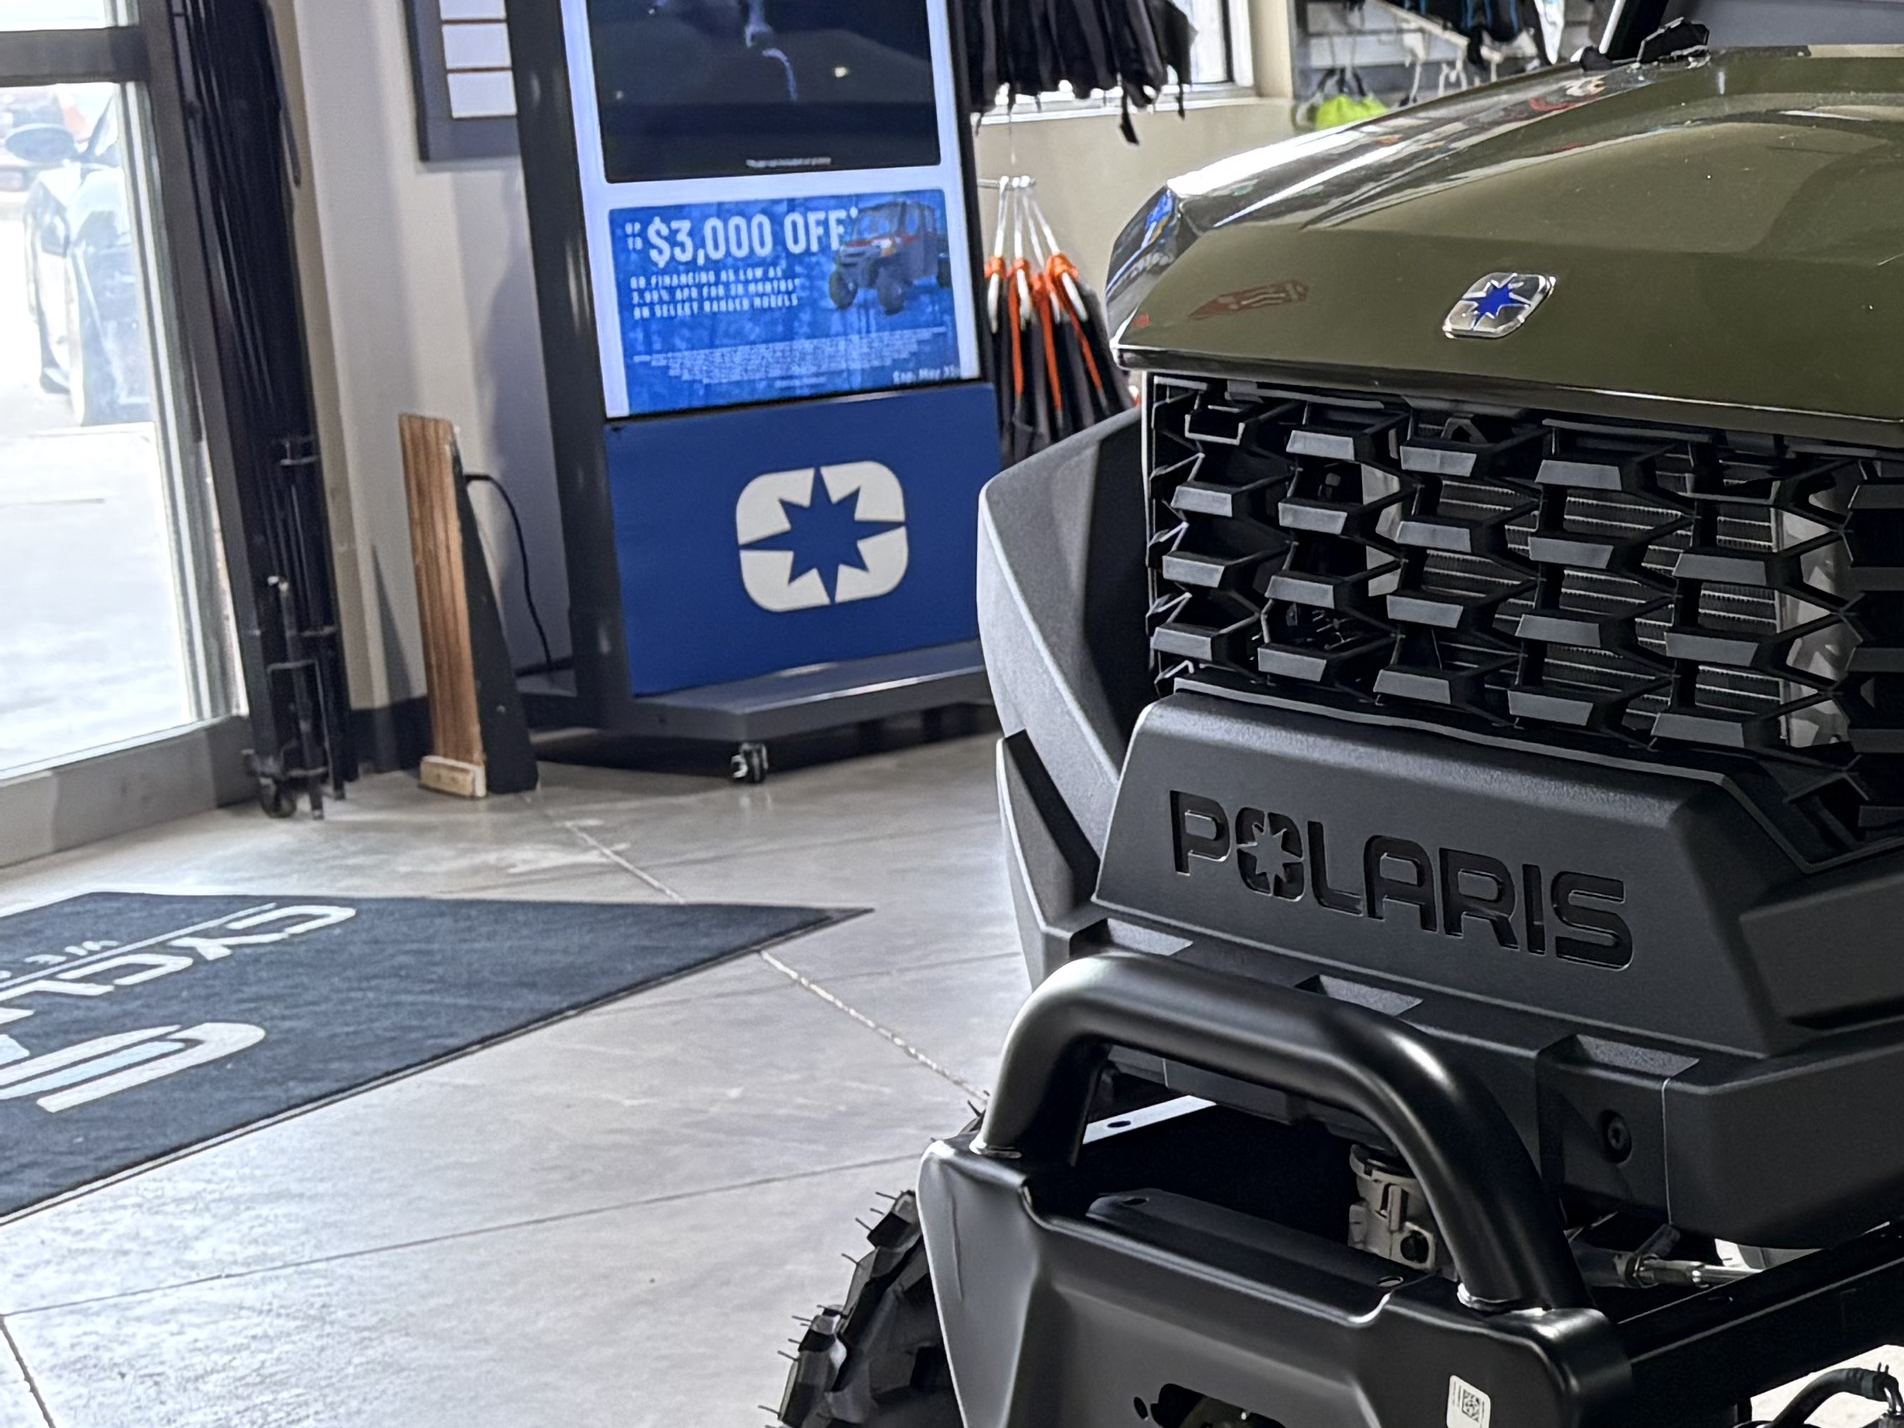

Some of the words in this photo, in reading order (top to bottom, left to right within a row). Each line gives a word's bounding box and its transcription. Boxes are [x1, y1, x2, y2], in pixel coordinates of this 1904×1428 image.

[625, 222, 642, 235] UP
[647, 213, 773, 269] $3,000
[739, 267, 763, 281] LOW
[1168, 789, 1636, 972] POLARIS
[0, 904, 357, 1025] CYCL
